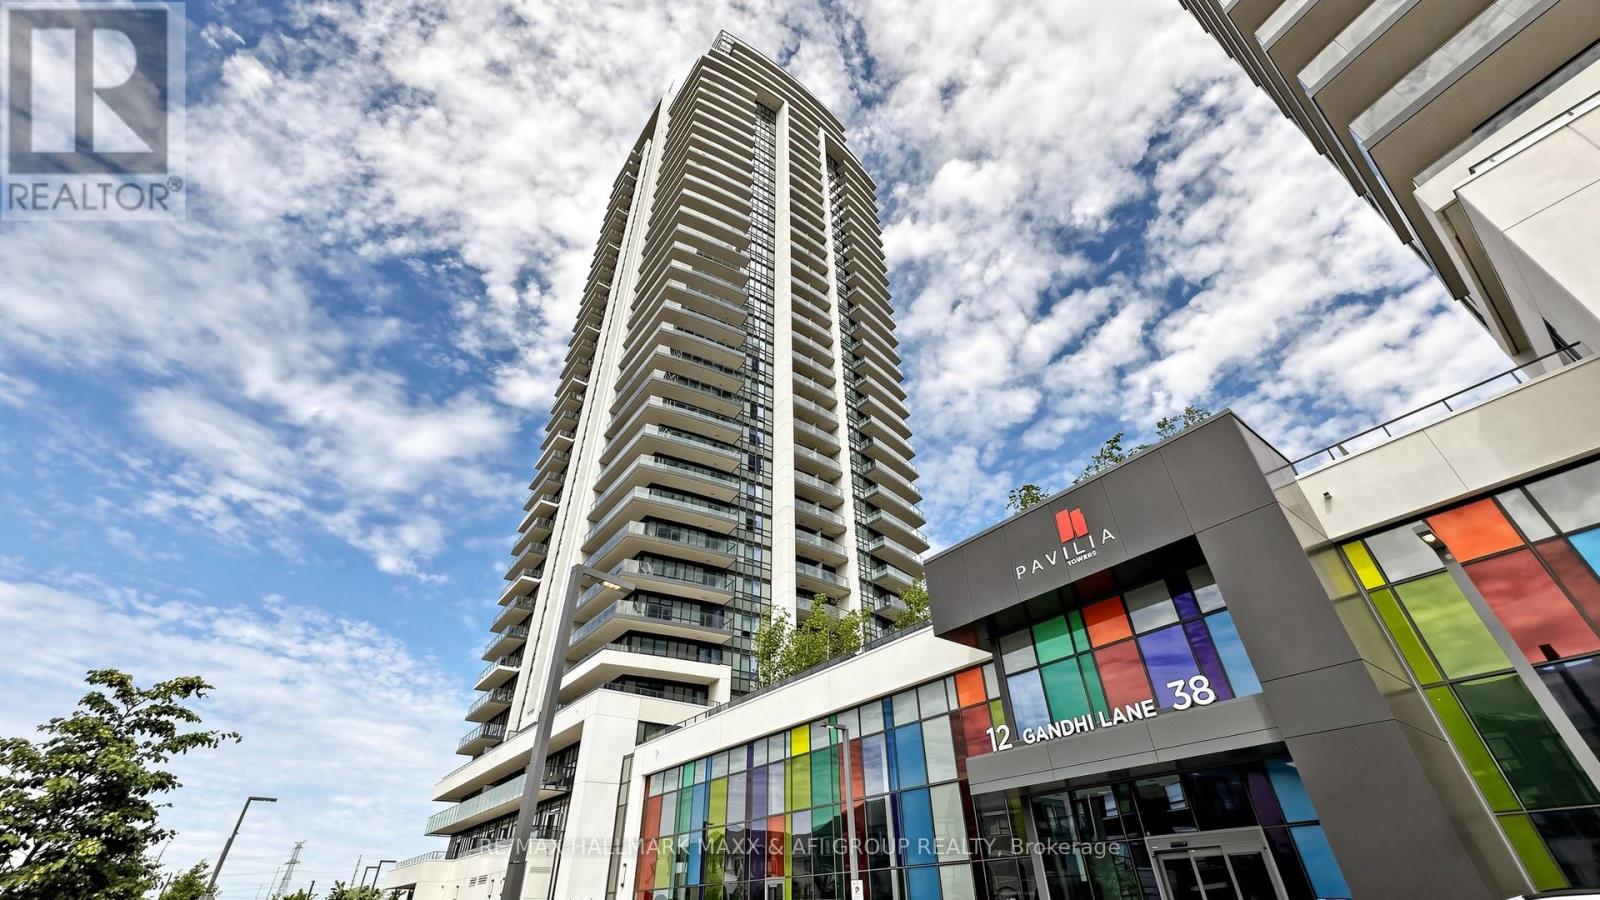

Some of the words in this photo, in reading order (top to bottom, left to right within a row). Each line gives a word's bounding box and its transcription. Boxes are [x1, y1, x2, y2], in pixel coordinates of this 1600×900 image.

[1015, 528, 1116, 580] PAVILIA
[1066, 550, 1097, 567] TOWERS
[985, 724, 1013, 753] 12
[1022, 714, 1095, 744] GANDHI
[1099, 698, 1157, 728] LANE
[1166, 674, 1216, 711] 38
